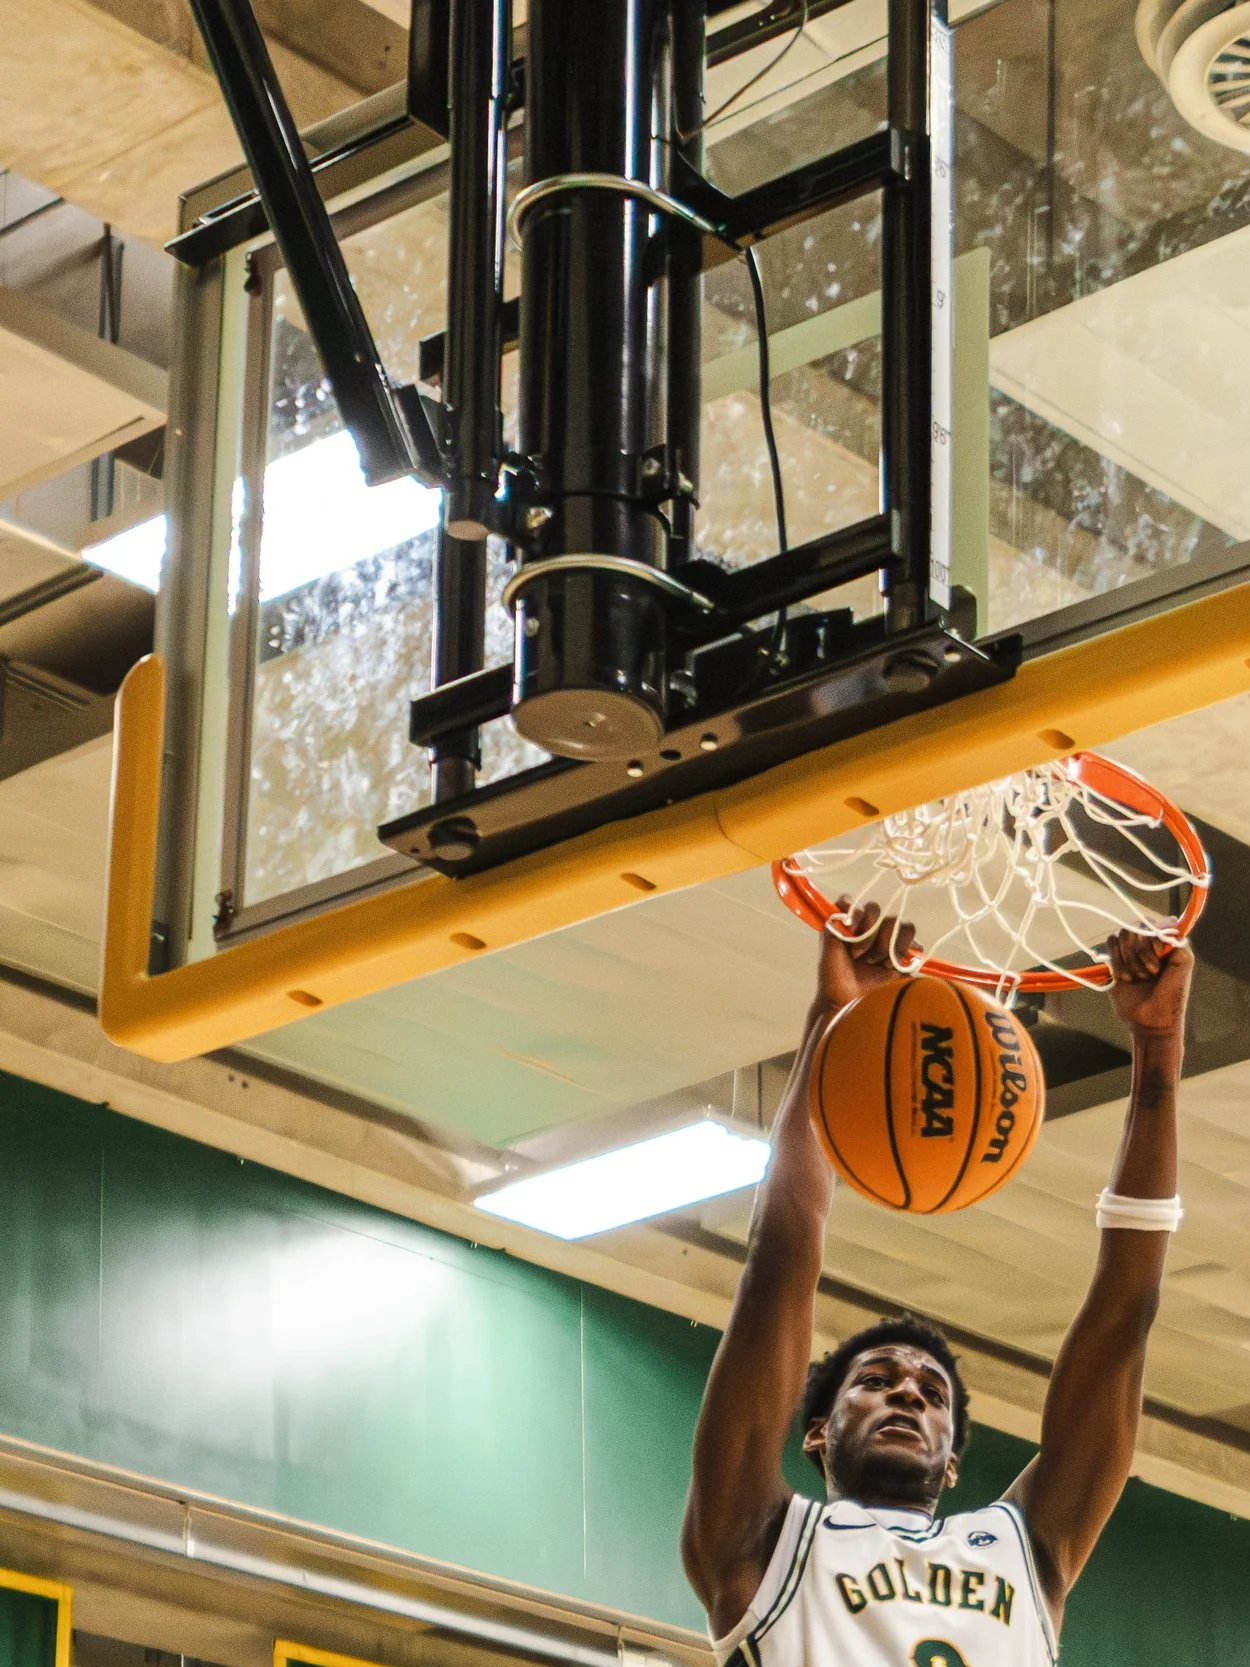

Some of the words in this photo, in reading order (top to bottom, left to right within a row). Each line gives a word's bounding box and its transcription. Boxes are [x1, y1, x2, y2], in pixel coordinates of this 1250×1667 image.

[920, 1021, 954, 1138] NCAA
[980, 1010, 1027, 1164] Wilson
[834, 1557, 1016, 1627] GOLDEN
